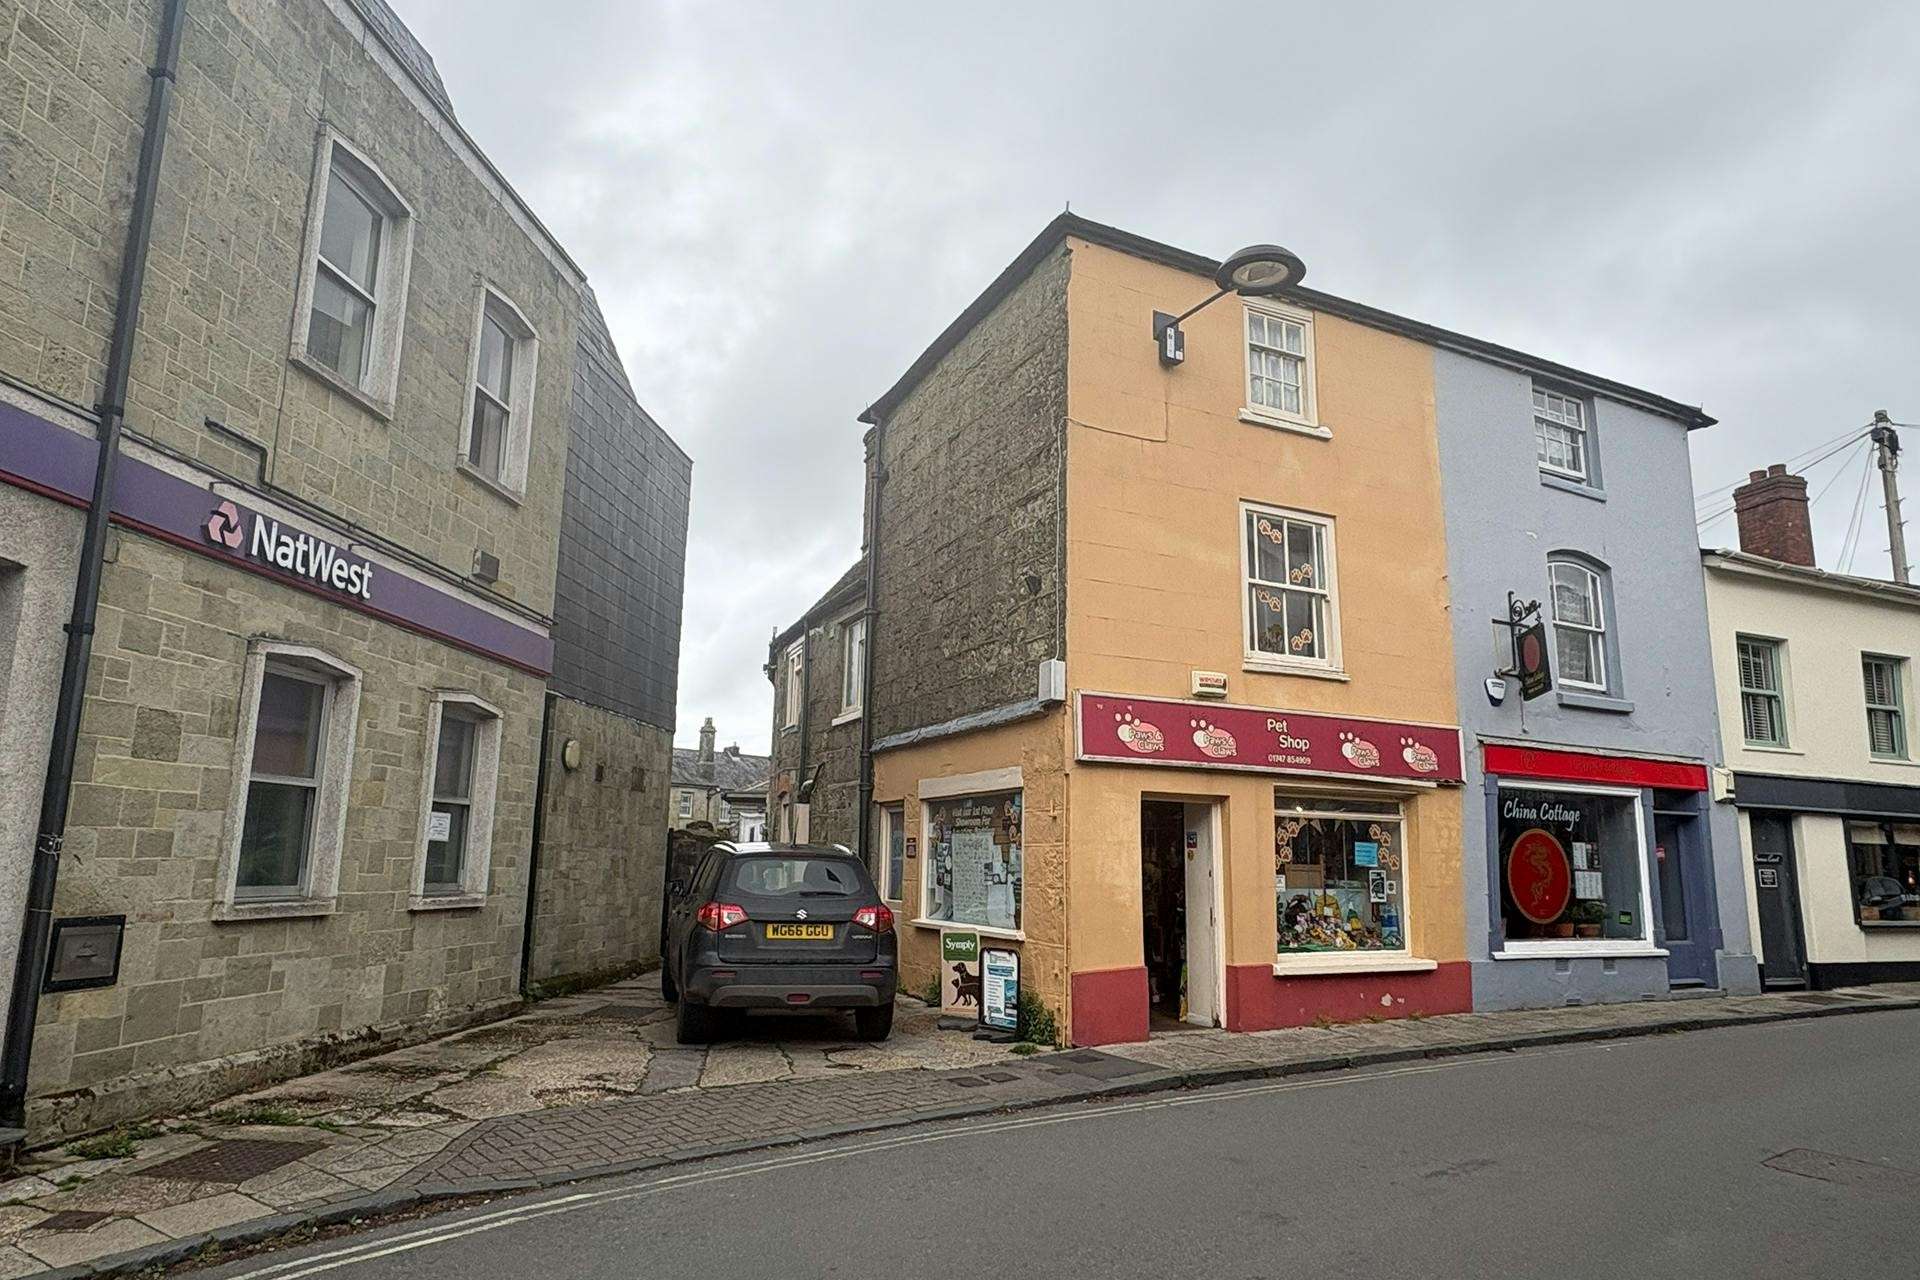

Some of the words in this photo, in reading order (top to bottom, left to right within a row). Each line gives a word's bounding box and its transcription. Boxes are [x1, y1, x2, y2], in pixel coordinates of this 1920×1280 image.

[251, 514, 373, 599] NatWest
[1267, 719, 1288, 733] Pet
[1128, 728, 1153, 743] Paws
[1203, 735, 1228, 748] Paws
[1137, 740, 1165, 752] Claws
[1279, 735, 1310, 752] Shop
[1212, 745, 1238, 757] Claws
[1503, 797, 1537, 820] China
[1540, 802, 1581, 832] Cottage
[771, 924, 803, 936] WG66
[806, 924, 829, 937] GGU
[945, 937, 976, 951] Symply
